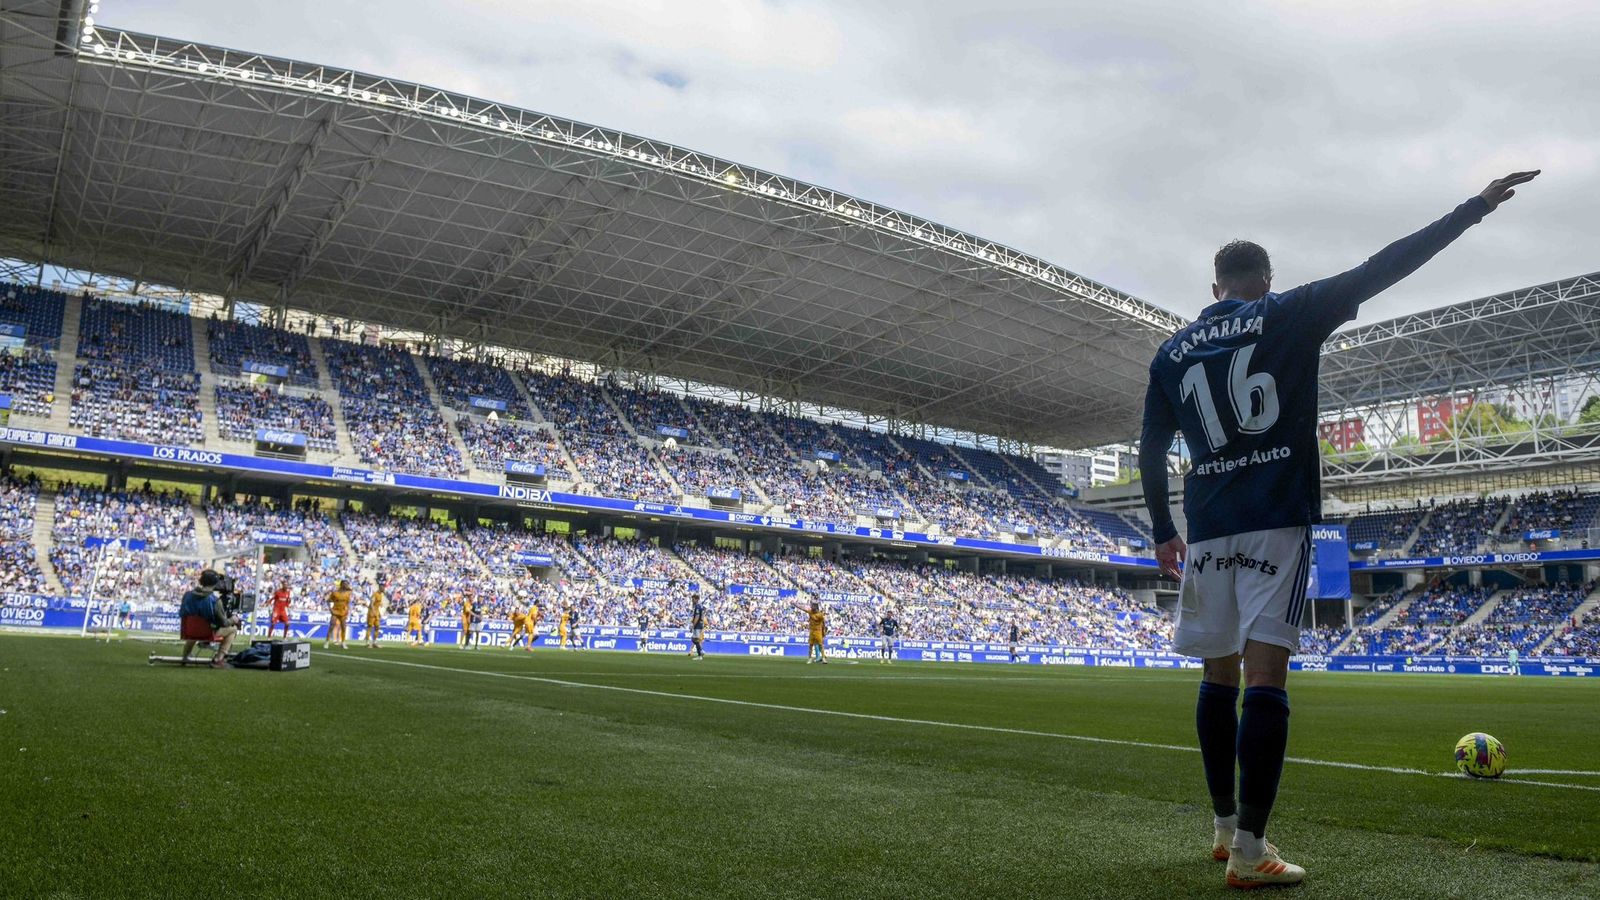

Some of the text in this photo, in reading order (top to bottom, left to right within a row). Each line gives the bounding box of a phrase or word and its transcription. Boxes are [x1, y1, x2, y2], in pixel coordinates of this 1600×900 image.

[1169, 316, 1264, 363] CAMARASA
[1179, 343, 1280, 453] 16
[153, 446, 223, 465] LOS PRADOS
[1192, 446, 1291, 477] artiere Auto
[499, 485, 552, 503] INDIBA
[1451, 555, 1484, 565] OVIEDO
[1503, 552, 1538, 563] OVIEDO
[753, 587, 779, 596] ESTADIO
[636, 638, 687, 653] Trtiere Auto
[749, 645, 784, 657] DIGI
[1402, 664, 1445, 673] Tartiere Auto
